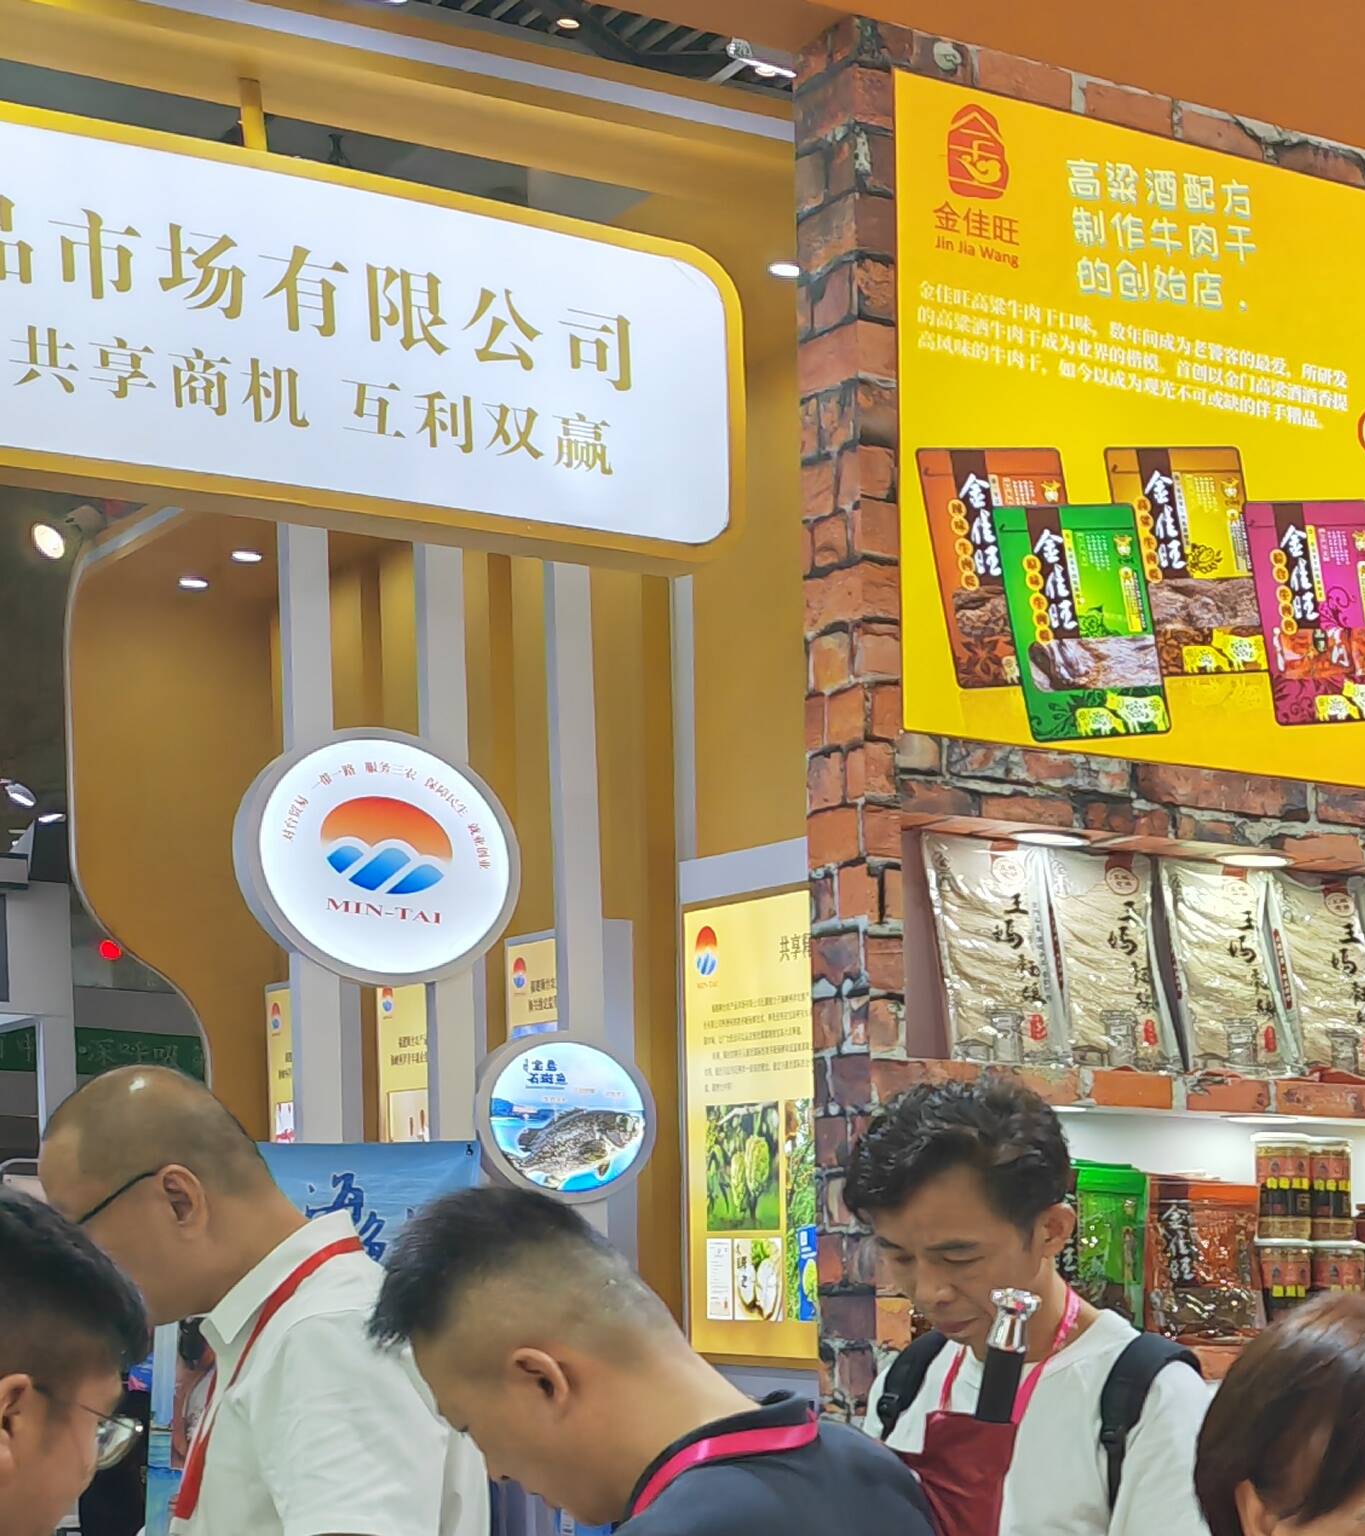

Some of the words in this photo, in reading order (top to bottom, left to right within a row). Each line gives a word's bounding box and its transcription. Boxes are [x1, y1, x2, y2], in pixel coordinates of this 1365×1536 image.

[1067, 158, 1251, 221] 高粱酒配方
[933, 200, 1020, 246] 金佳旺
[1072, 206, 1256, 268] 制作牛肉干
[935, 235, 954, 251] Jin
[957, 240, 976, 257] Jia
[979, 245, 1019, 269] Wang
[9, 324, 310, 431] 共享商机
[341, 378, 616, 476] 互利双赢
[326, 897, 442, 925] MIN-TAI
